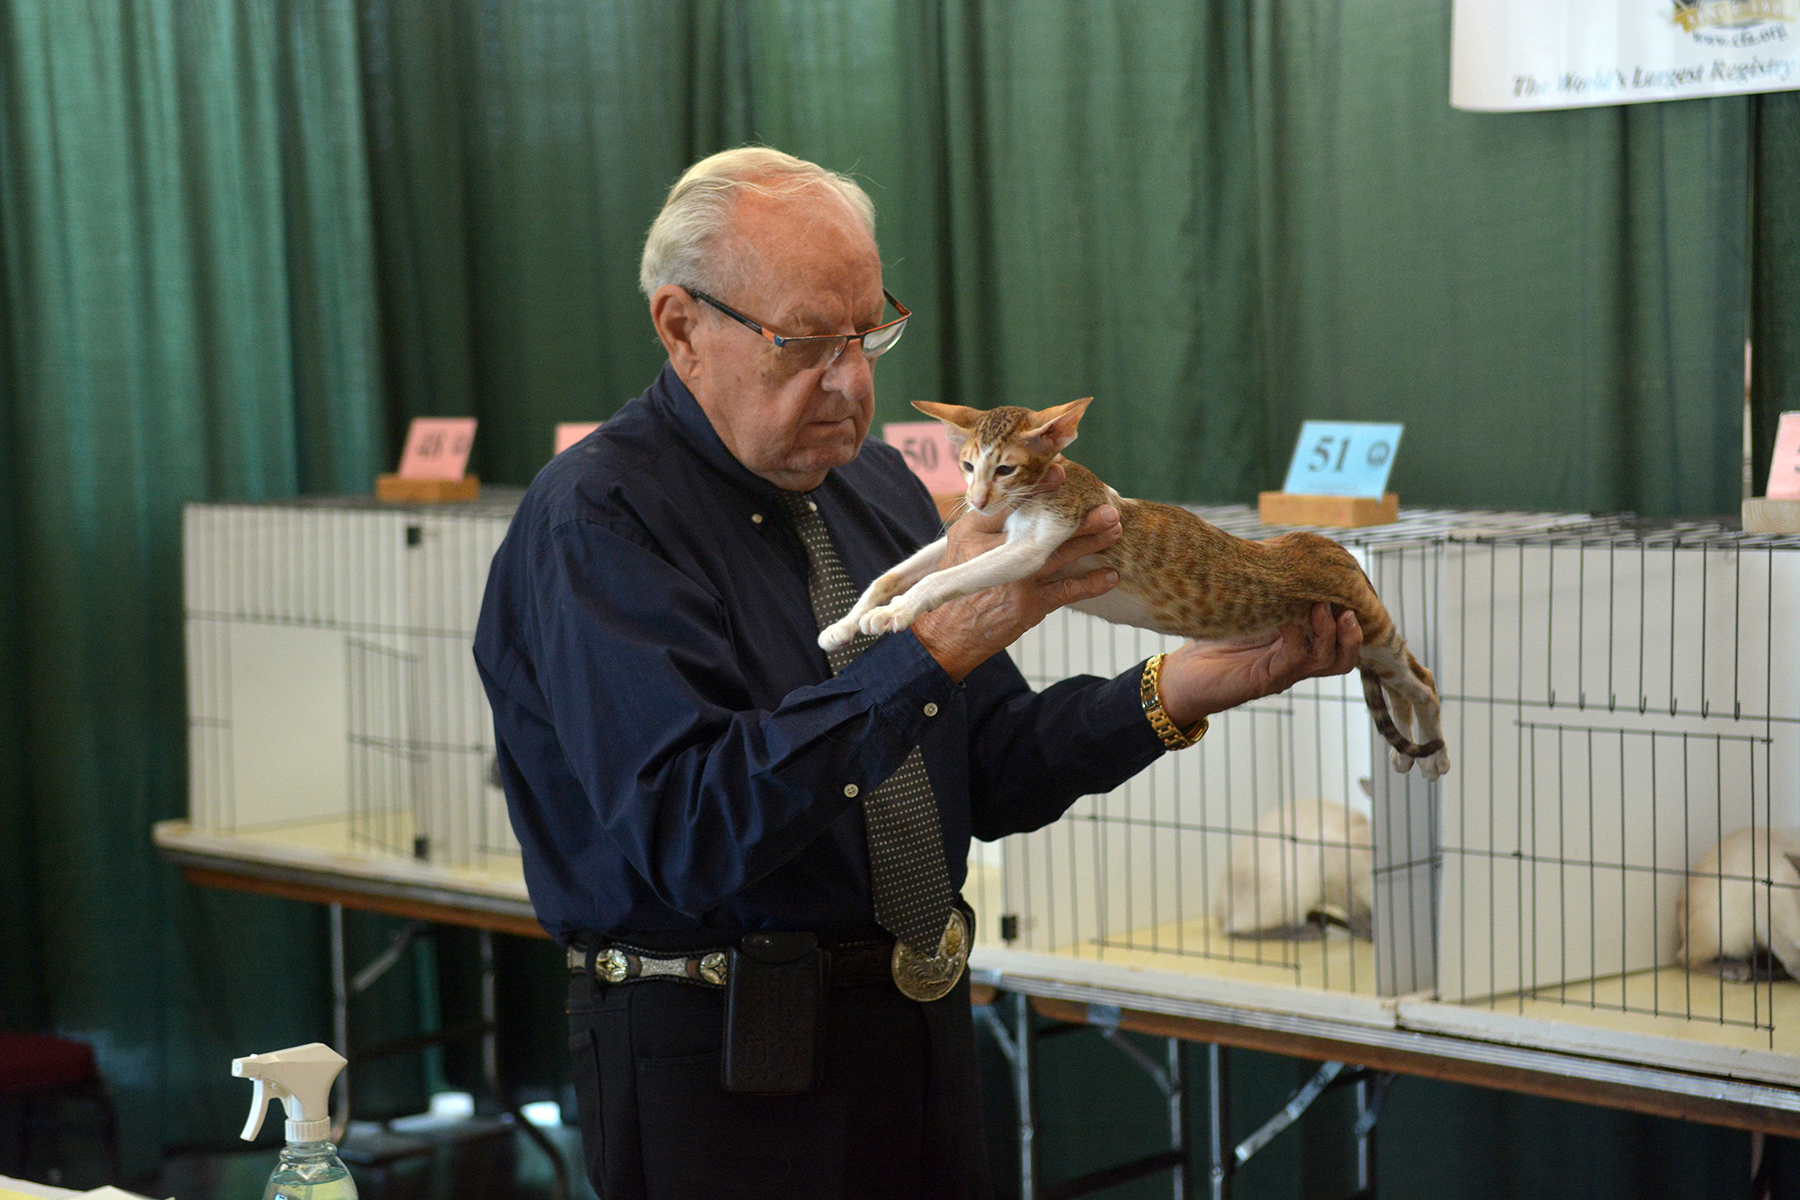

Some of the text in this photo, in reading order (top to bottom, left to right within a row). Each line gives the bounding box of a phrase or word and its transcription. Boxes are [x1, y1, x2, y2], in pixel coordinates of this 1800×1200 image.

[1692, 23, 1788, 47] www.cfa.org
[1512, 73, 1551, 96] The
[1632, 64, 1704, 92] Largest
[1710, 55, 1795, 84] Registry
[902, 436, 938, 473] 50
[1308, 434, 1352, 473] 51
